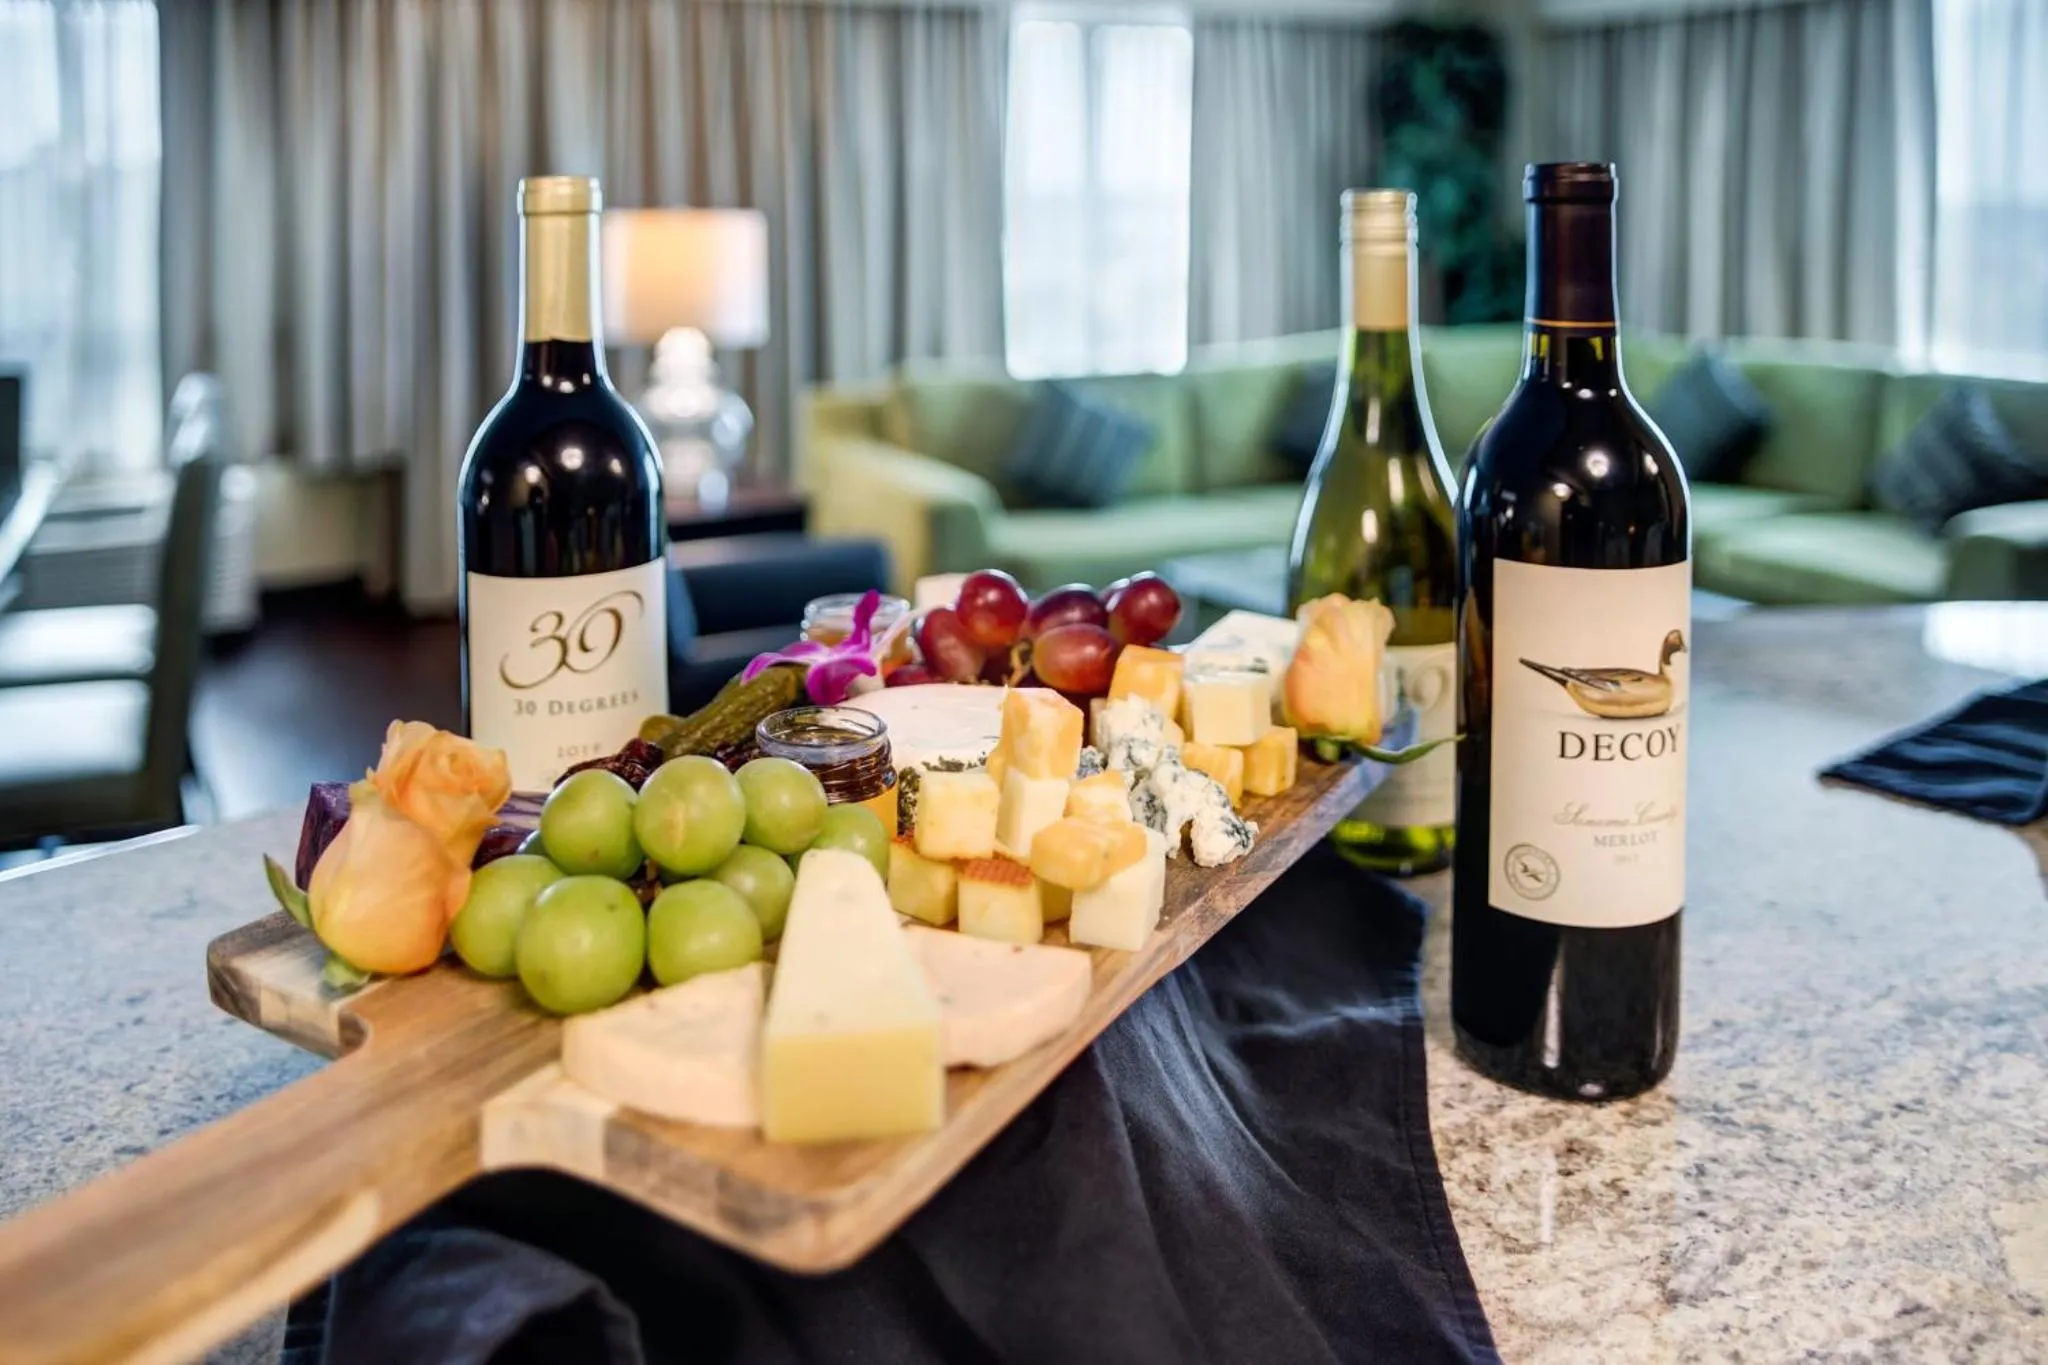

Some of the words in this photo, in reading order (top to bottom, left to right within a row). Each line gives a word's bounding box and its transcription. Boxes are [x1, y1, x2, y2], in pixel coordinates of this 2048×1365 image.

[499, 589, 645, 689] 30
[513, 698, 538, 716] 30
[548, 689, 639, 716] DEGREES
[1558, 724, 1680, 761] DECOY
[1593, 830, 1660, 848] MERLOT
